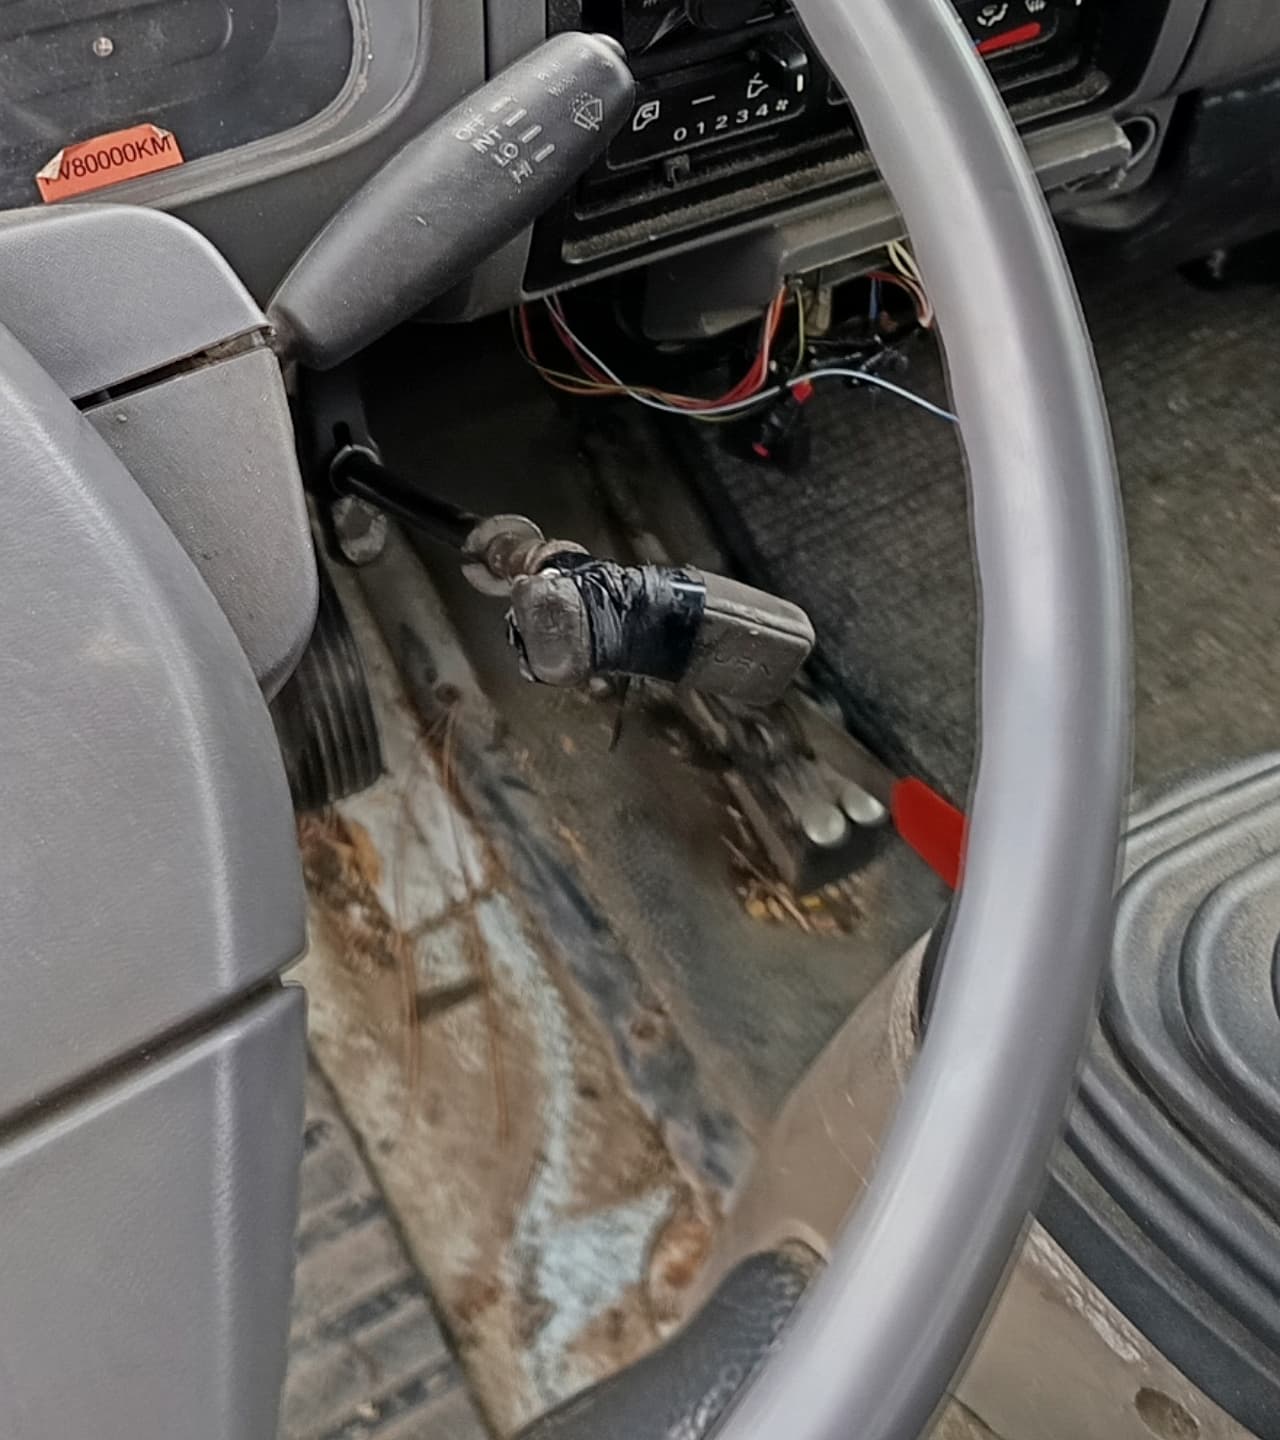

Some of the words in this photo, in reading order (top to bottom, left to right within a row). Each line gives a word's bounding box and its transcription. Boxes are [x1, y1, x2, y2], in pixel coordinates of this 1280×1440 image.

[456, 113, 485, 141] OFF
[673, 128, 688, 142] 0
[696, 121, 705, 135] 1
[715, 115, 729, 130] 2
[736, 109, 749, 123] 3
[755, 103, 769, 117] 4
[472, 126, 502, 154] INT
[44, 136, 173, 185] V80000KM
[492, 142, 519, 167] LO
[511, 160, 534, 184] HI
